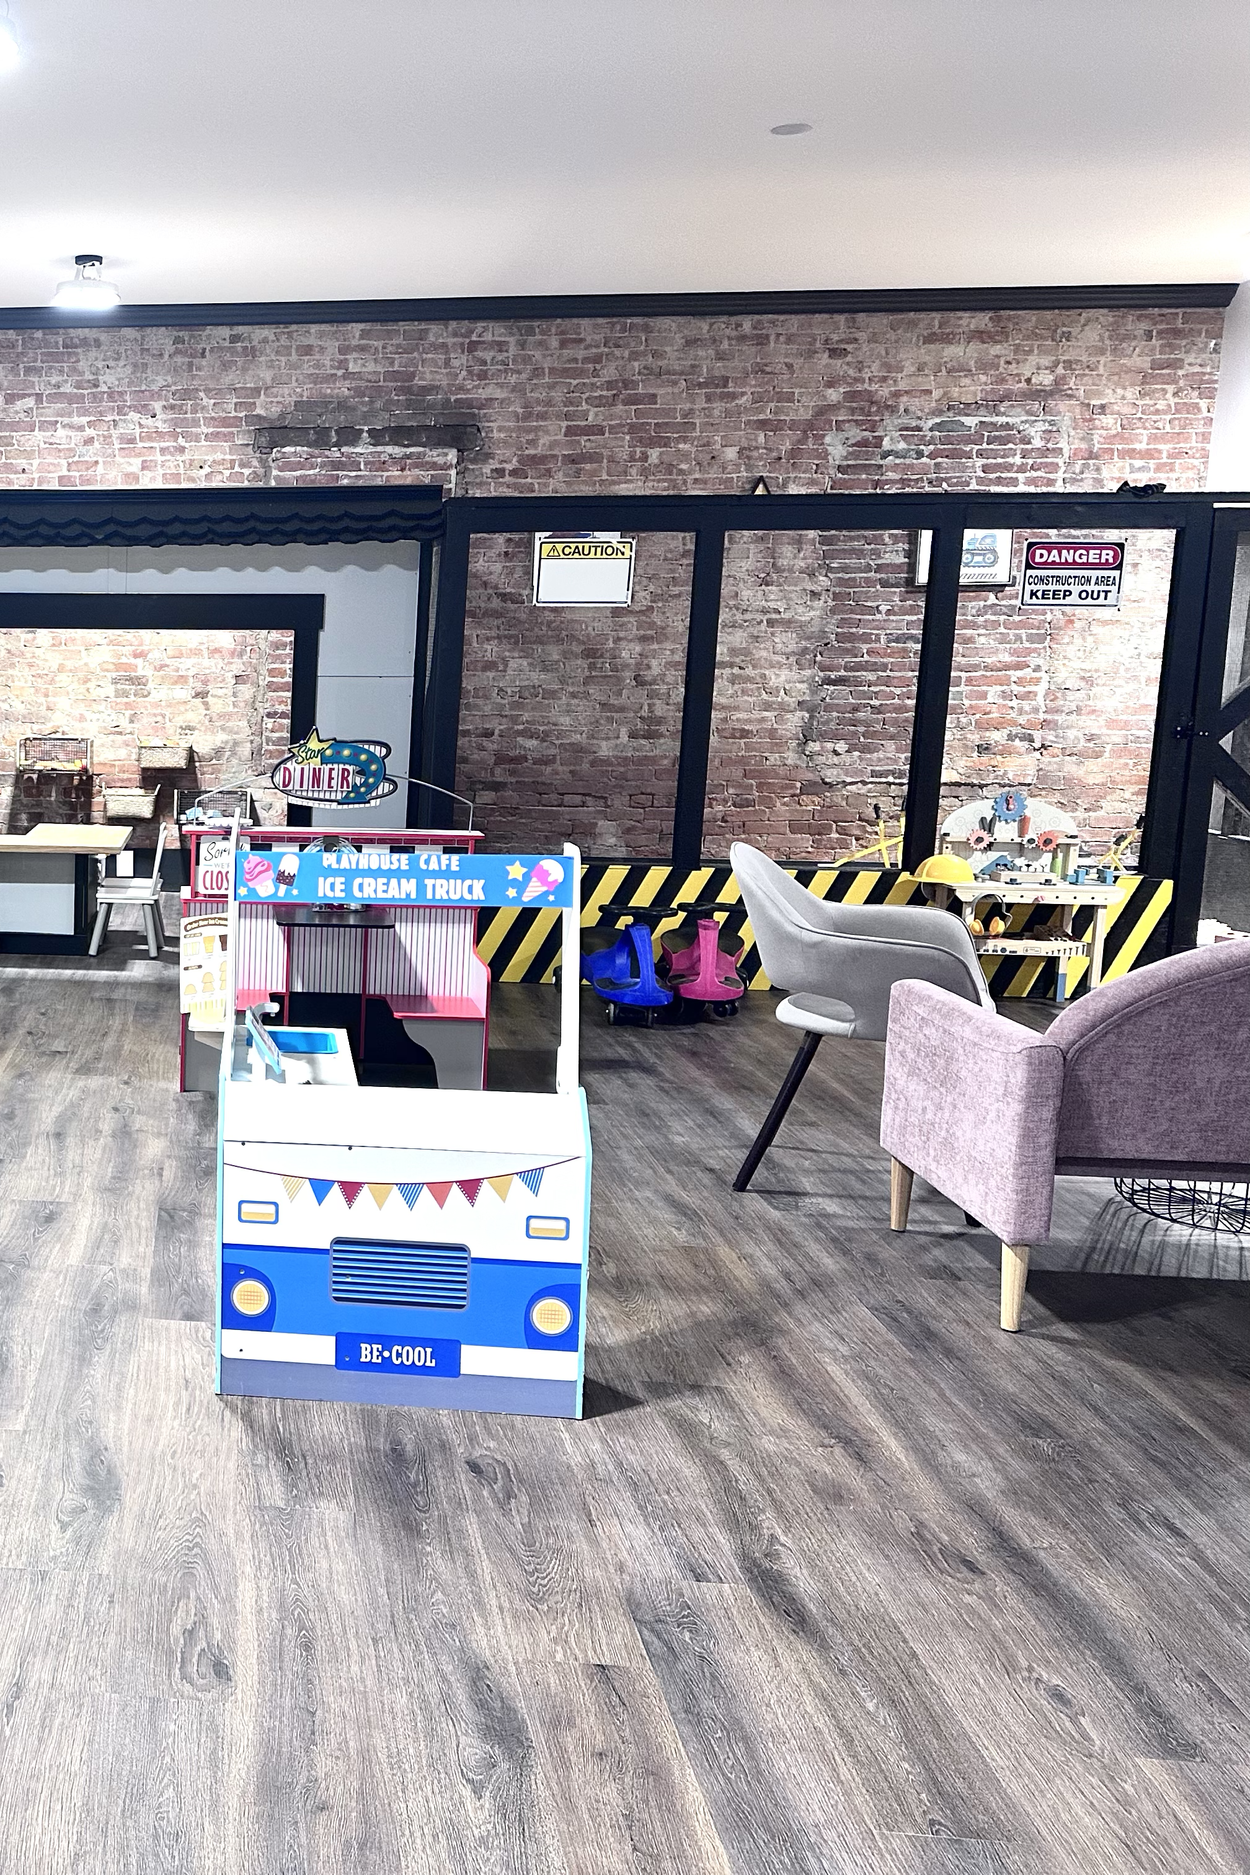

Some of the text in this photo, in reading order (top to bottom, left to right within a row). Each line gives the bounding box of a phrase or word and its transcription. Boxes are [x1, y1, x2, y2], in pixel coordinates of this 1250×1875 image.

[561, 544, 626, 557] CAUTION
[1034, 549, 1114, 563] DANGER
[1027, 574, 1117, 587] CONSTRUCTION AREA
[1029, 589, 1112, 601] KEEP OUT
[295, 744, 326, 765] Star
[282, 766, 351, 789] DINER
[322, 853, 460, 871] PLAYHOUSE CAFE
[317, 876, 486, 900] ICE CREAM TRUCK
